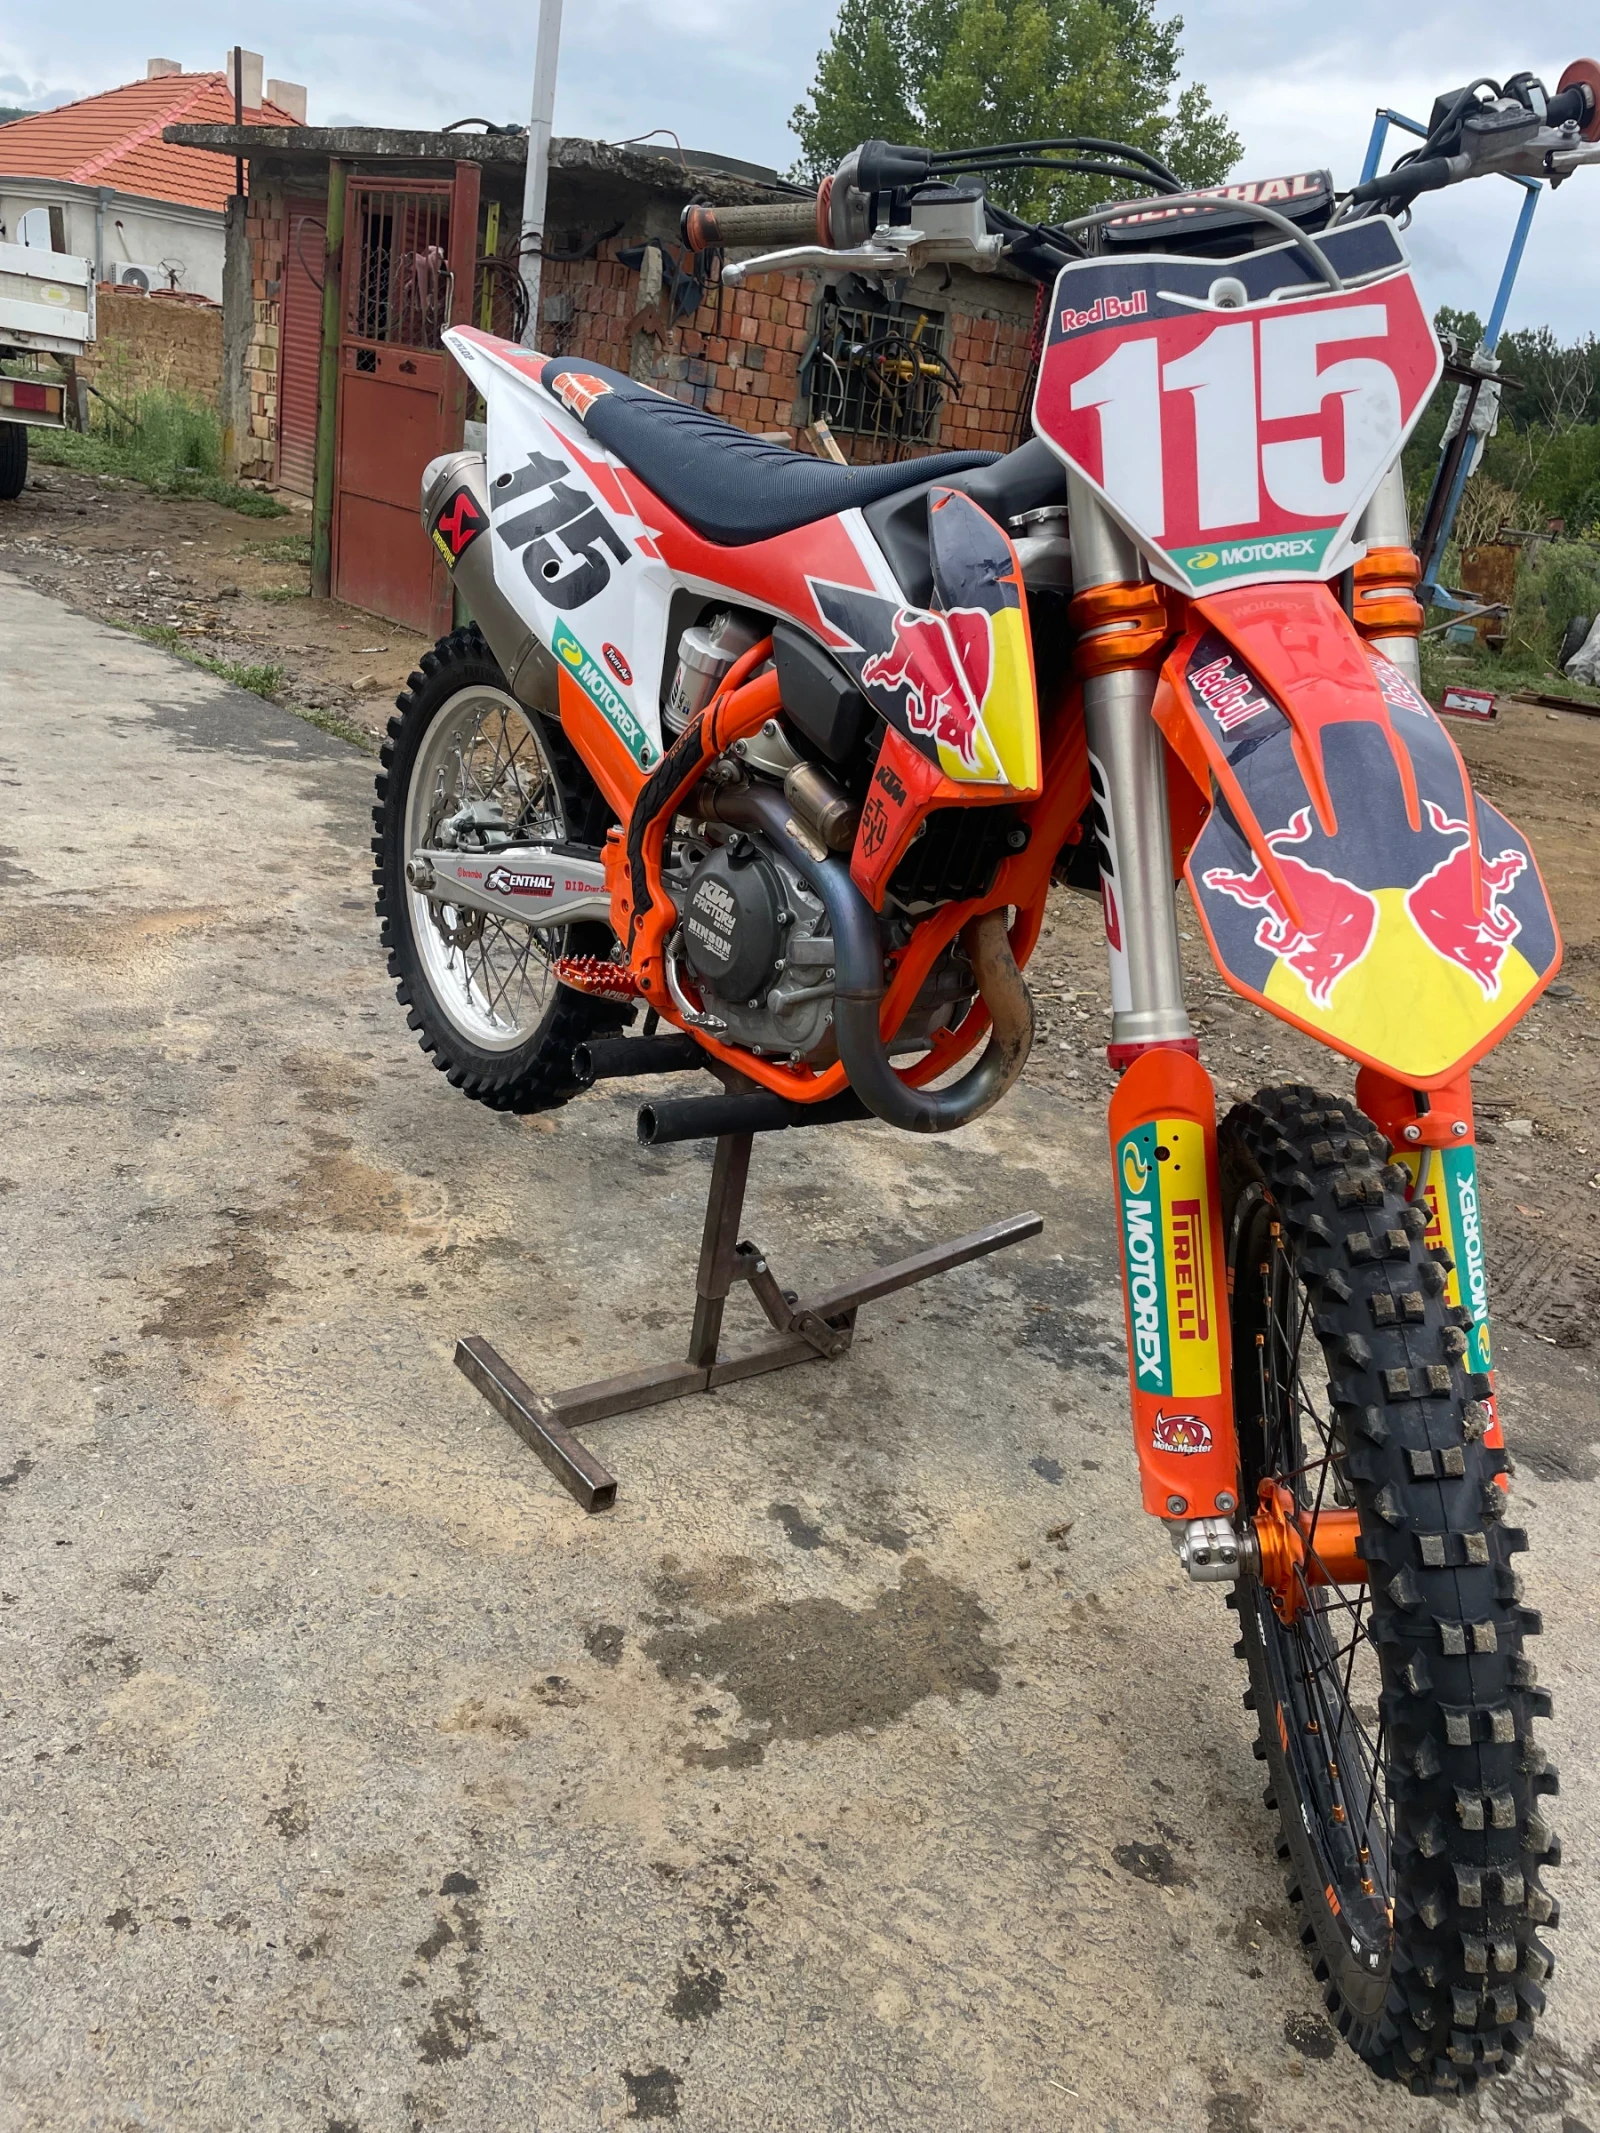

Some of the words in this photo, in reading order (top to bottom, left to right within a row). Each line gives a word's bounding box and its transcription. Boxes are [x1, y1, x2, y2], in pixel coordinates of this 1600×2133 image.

[1061, 298, 1103, 333] Red
[1104, 290, 1148, 320] Bull
[1070, 304, 1402, 538] 115
[489, 451, 632, 610] 115
[1221, 539, 1316, 566] MOTOREX
[606, 647, 622, 670] Twin
[619, 667, 630, 680] Air
[1188, 655, 1248, 702] Red
[579, 660, 640, 746] MOTOREX
[1206, 679, 1271, 732] Bull
[875, 765, 907, 808] KTM
[692, 893, 736, 929] FACTORY
[699, 880, 734, 913] KTM
[688, 917, 732, 955] HINSON
[602, 988, 630, 1000] APICO
[1457, 1172, 1488, 1322] MOTOREX
[1125, 1199, 1163, 1381] MOTOREX
[1171, 1198, 1209, 1342] PIRELLI
